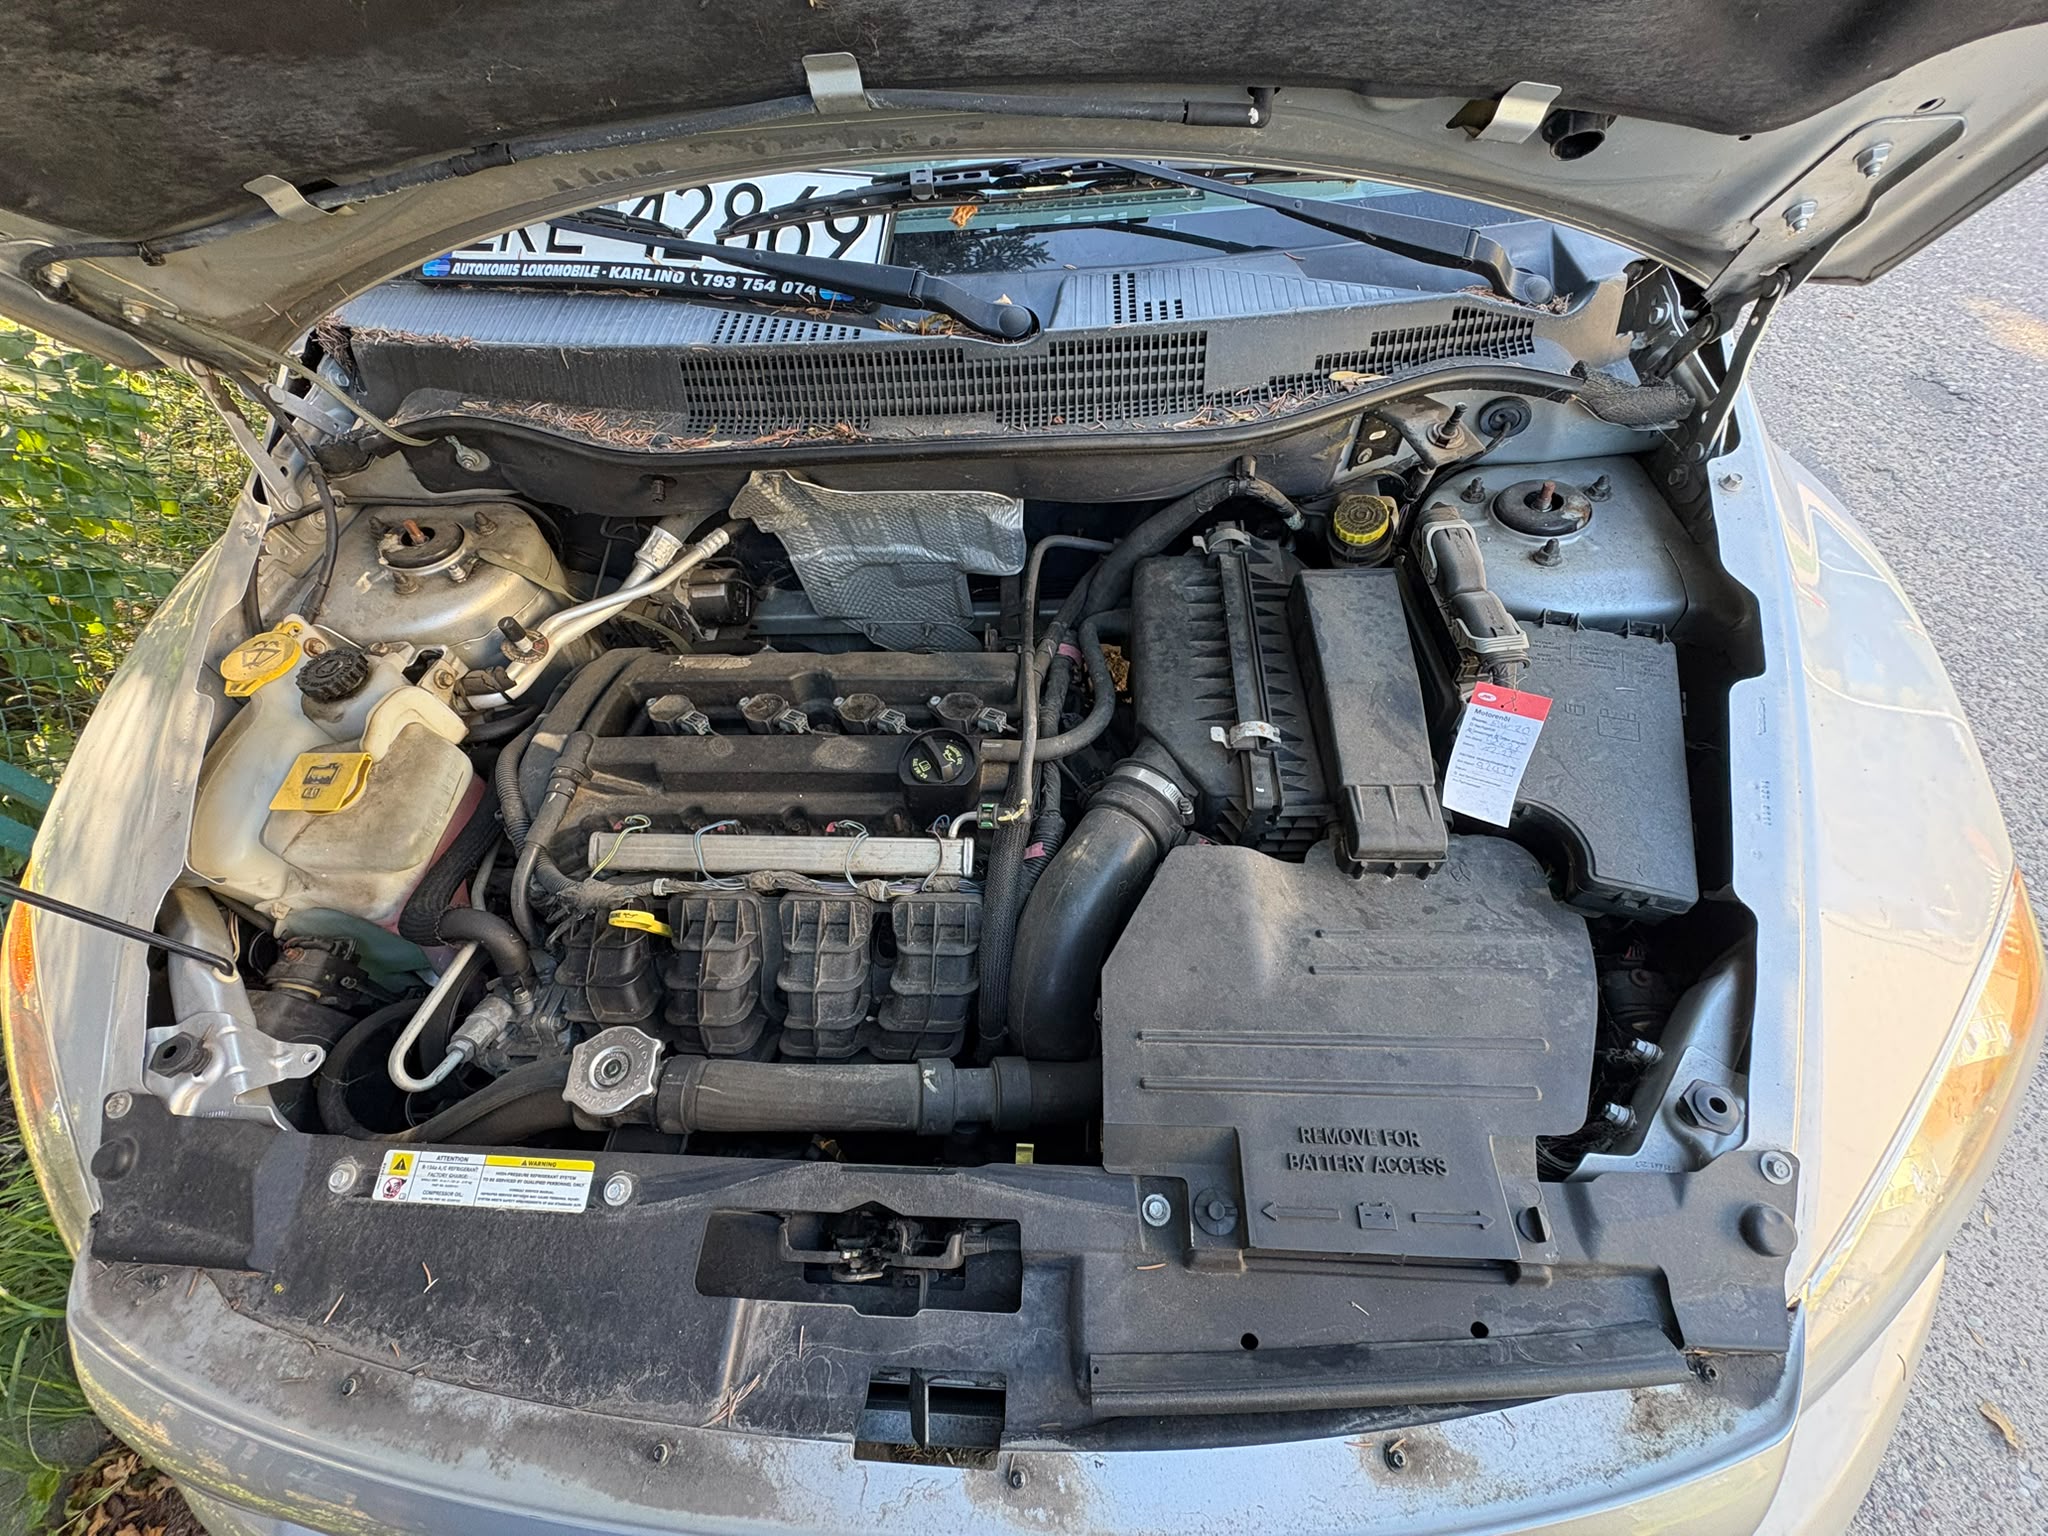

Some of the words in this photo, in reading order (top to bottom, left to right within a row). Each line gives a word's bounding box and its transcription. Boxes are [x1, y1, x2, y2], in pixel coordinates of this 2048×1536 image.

[452, 262, 520, 277] AUTOKOMIS
[521, 263, 599, 279] LOKOMOBILE
[608, 266, 685, 284] KARLINO
[702, 274, 735, 288] 793
[742, 276, 776, 292] 754
[780, 280, 816, 296] 074
[1474, 708, 1511, 722] Motorenöl
[1299, 1126, 1378, 1147] REMOVE
[1380, 1128, 1422, 1148] FOR
[528, 1160, 557, 1168] WARNING
[1287, 1153, 1367, 1173] BATTERY
[1372, 1155, 1450, 1176] ACCESS
